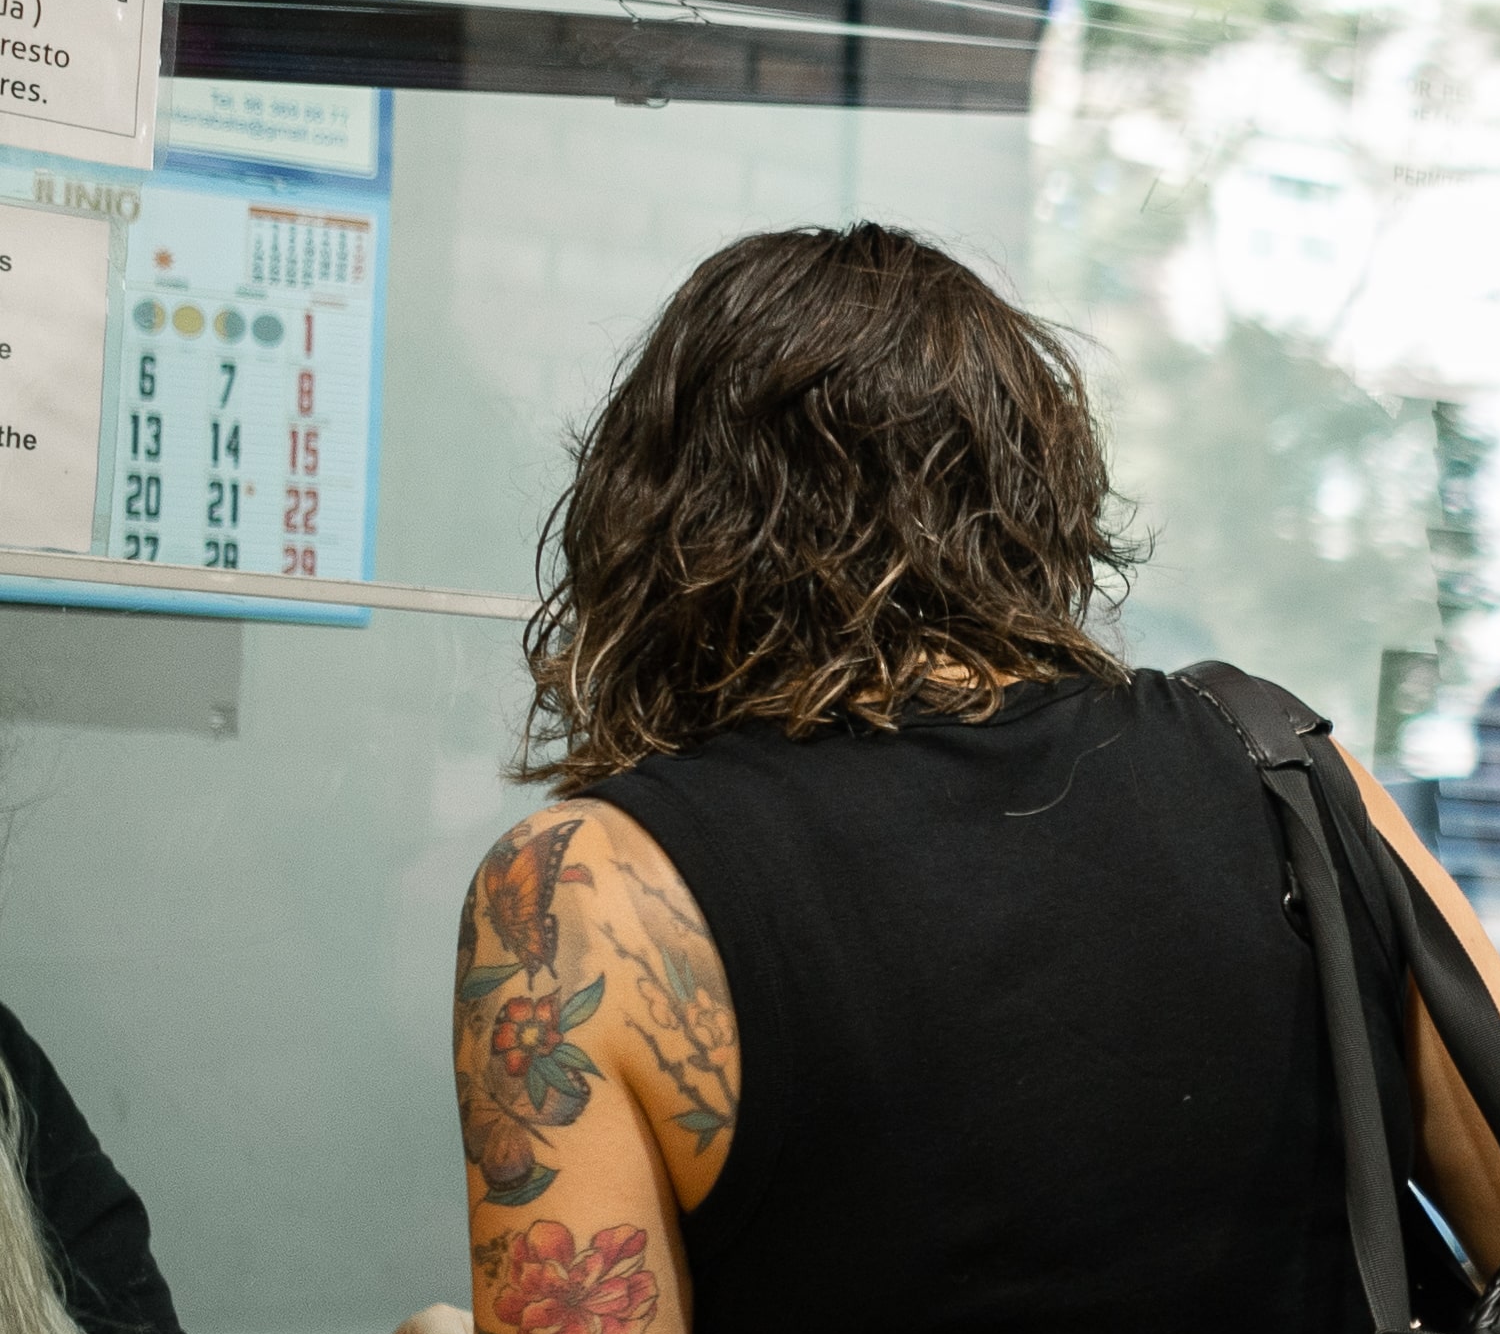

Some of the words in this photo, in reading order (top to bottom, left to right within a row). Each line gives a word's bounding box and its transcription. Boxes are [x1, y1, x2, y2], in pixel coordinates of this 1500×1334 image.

[1, 37, 70, 68] resto
[304, 311, 313, 358] 1
[140, 353, 156, 401] 6
[220, 363, 236, 409] 7
[298, 370, 314, 416] 8
[129, 413, 161, 461] 13
[210, 420, 240, 468] 14
[288, 428, 318, 476] 15
[125, 473, 161, 521] 20
[207, 480, 239, 528] 21
[284, 486, 318, 534] 22
